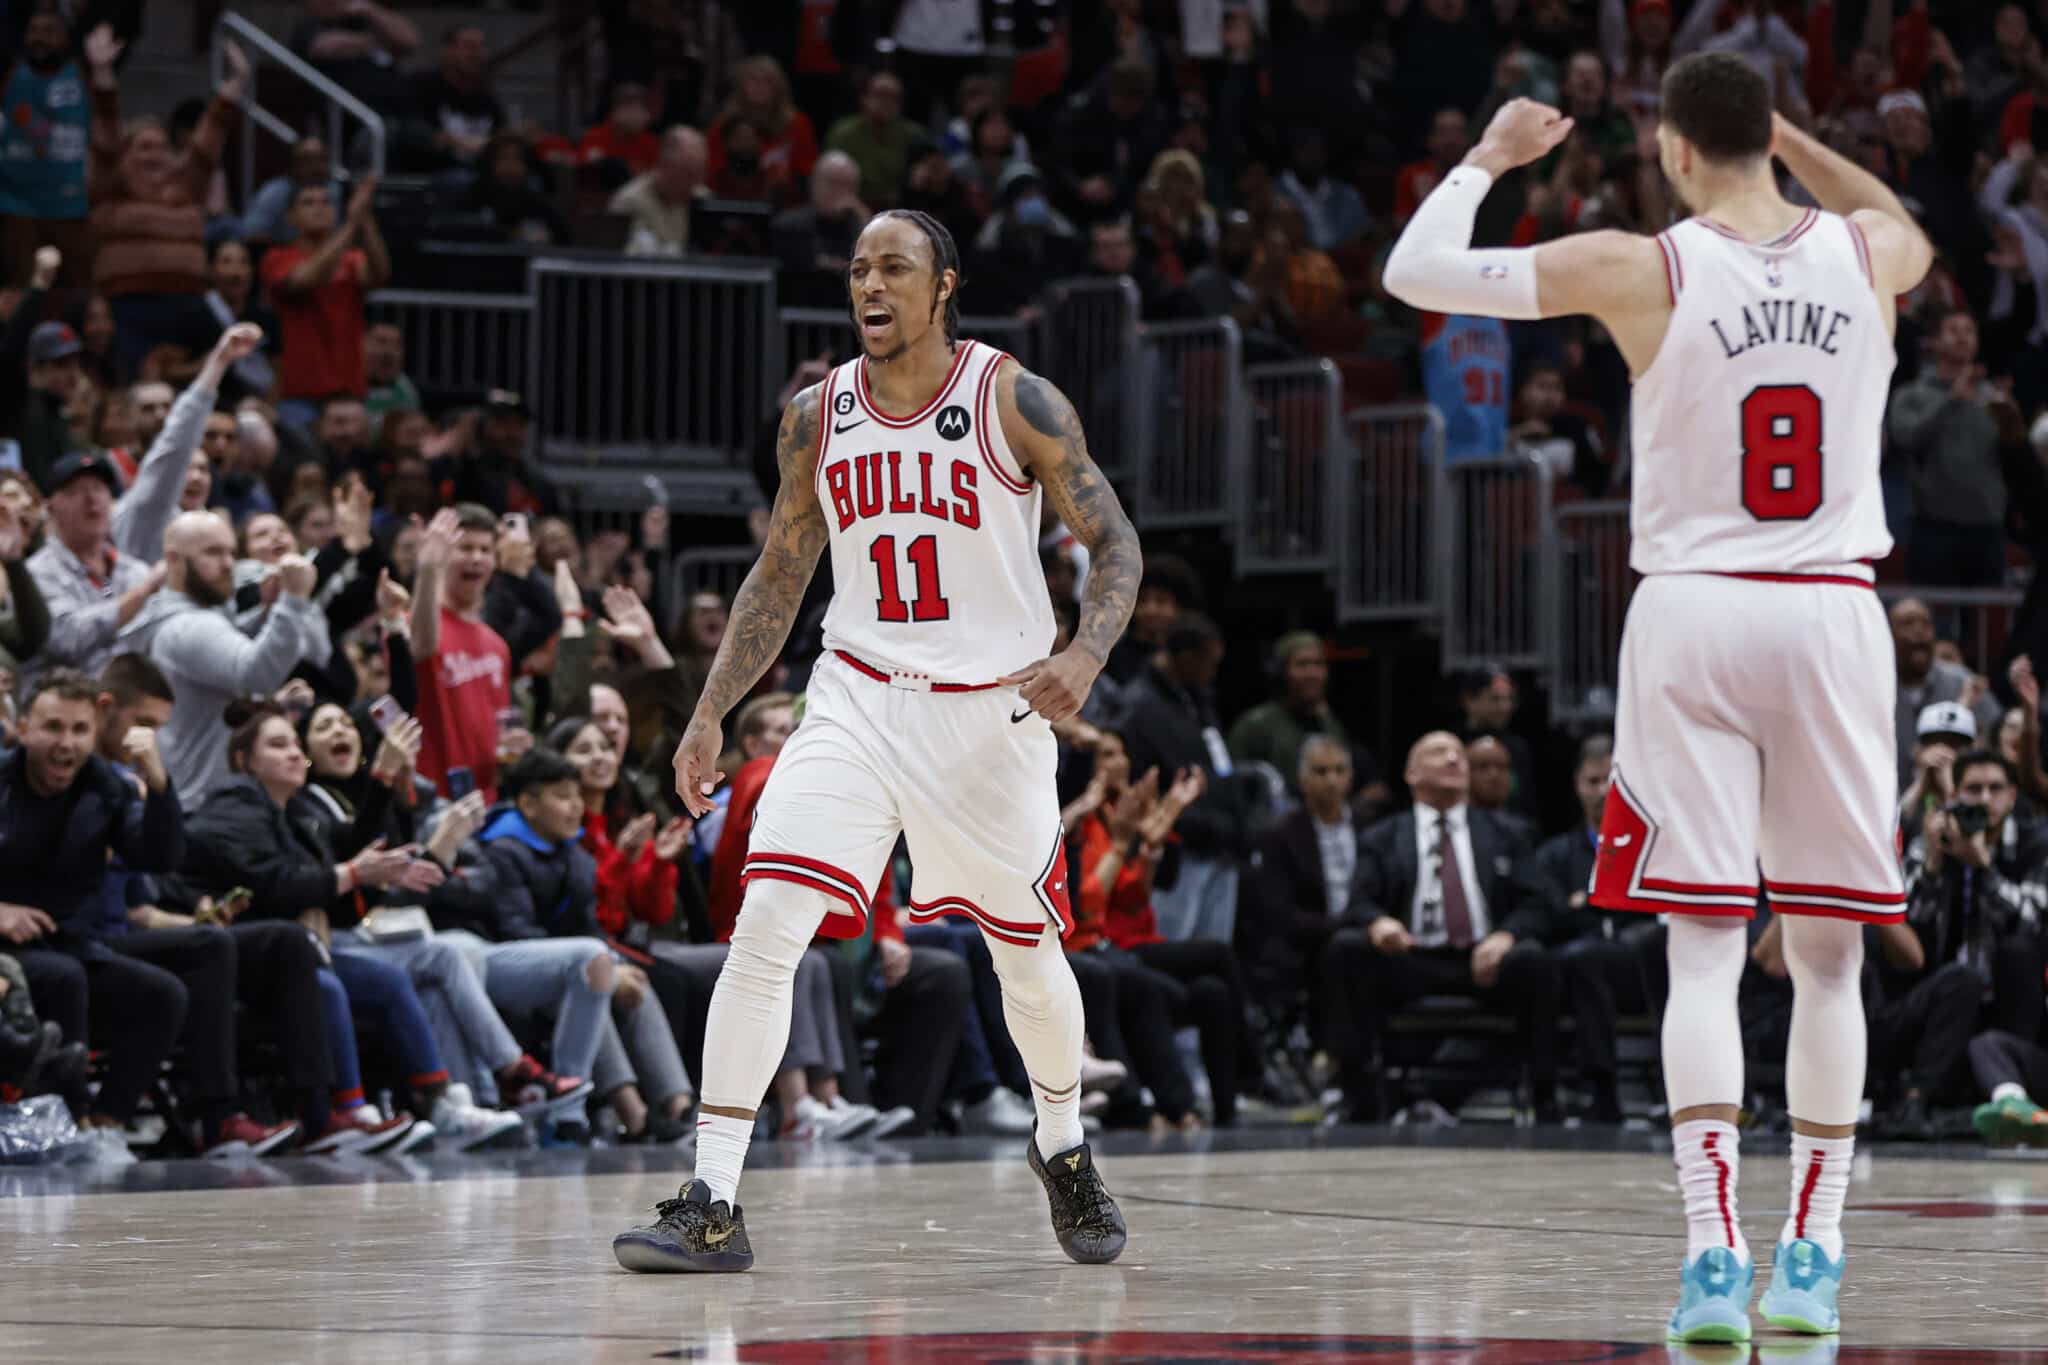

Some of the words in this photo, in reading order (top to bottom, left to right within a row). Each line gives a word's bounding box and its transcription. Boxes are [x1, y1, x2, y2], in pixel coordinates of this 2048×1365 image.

[1709, 299, 1852, 359] LAVINE
[838, 393, 851, 414] 6
[826, 451, 981, 533] BULLS
[1740, 383, 1824, 522] 8
[870, 534, 950, 623] 11
